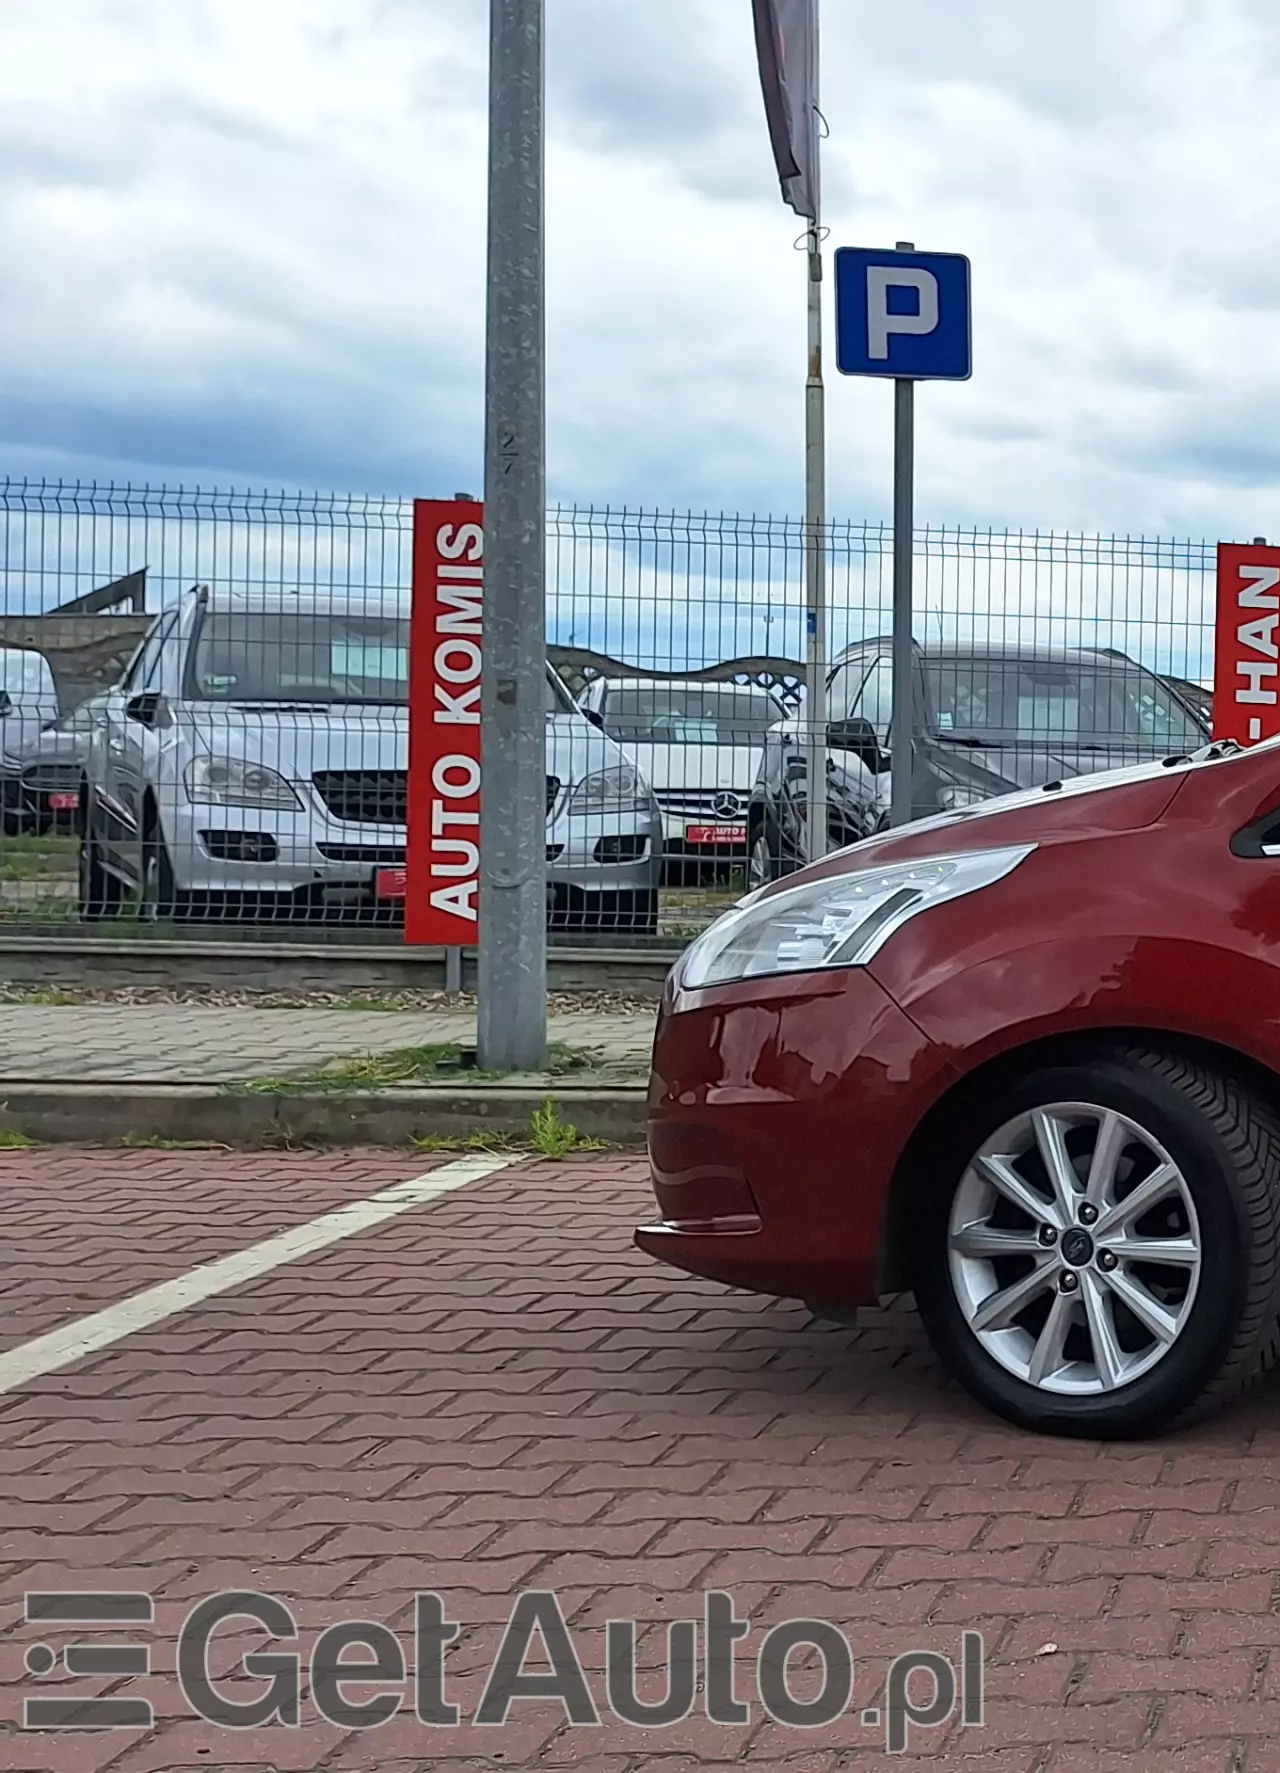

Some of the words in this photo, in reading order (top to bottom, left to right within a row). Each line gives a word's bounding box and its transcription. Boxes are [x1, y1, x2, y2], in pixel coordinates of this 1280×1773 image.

[867, 265, 938, 360] P
[433, 522, 484, 725] KOMIS
[430, 753, 483, 922] AUTO
